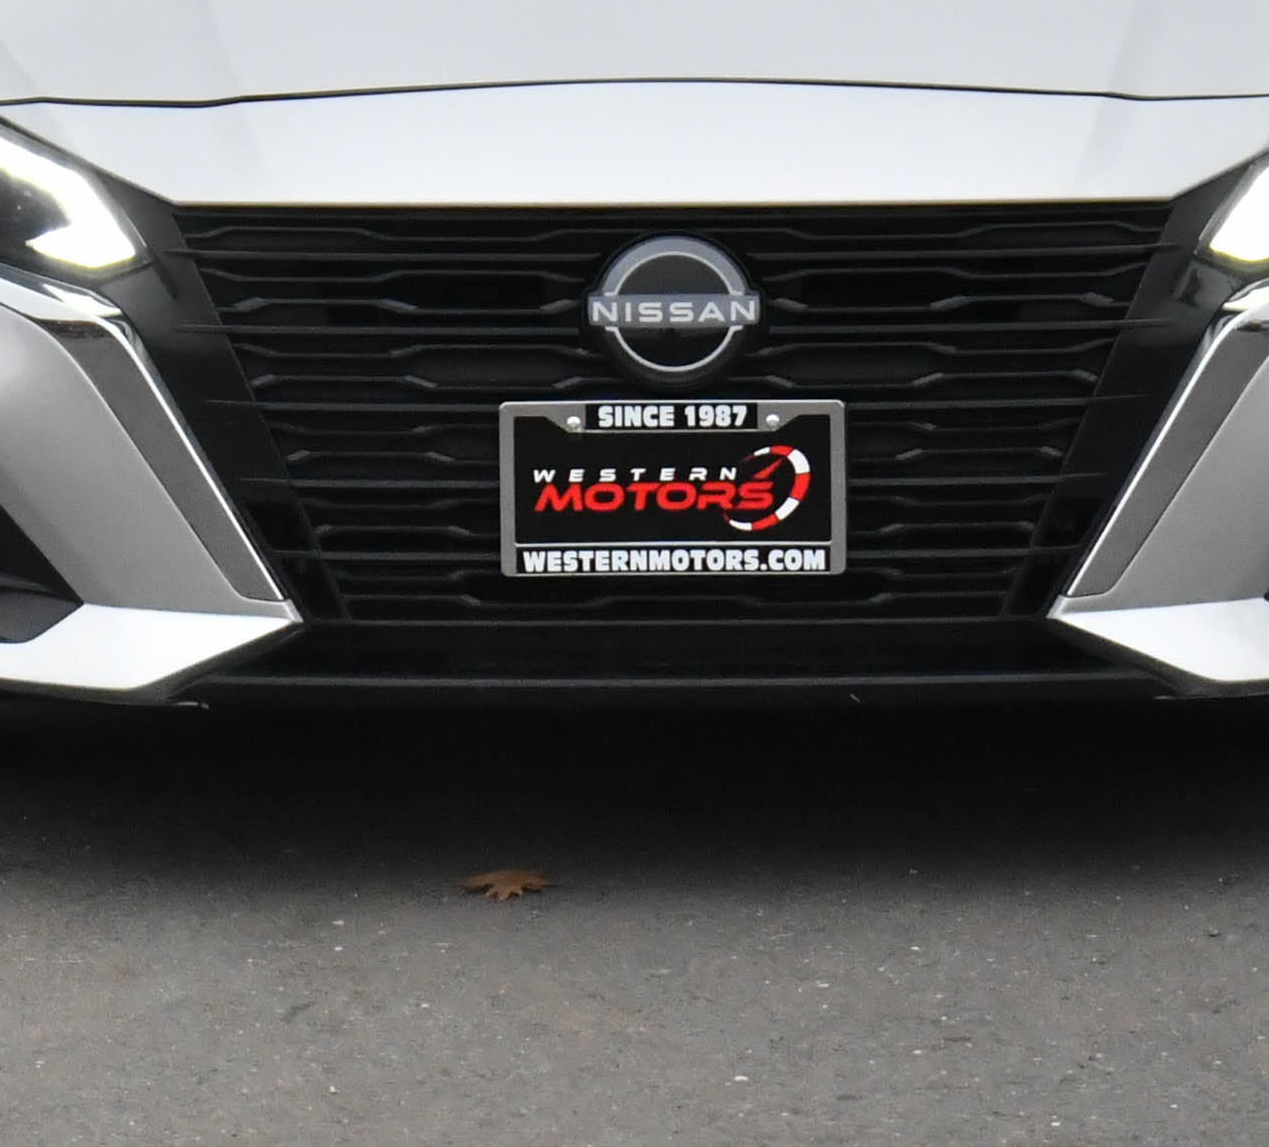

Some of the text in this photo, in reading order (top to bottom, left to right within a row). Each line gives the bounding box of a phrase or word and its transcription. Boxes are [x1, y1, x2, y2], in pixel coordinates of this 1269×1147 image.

[592, 300, 756, 323] NISSAN
[597, 405, 748, 428] SINCE 1987
[533, 467, 737, 484] WESTERN
[534, 481, 774, 512] MOTORS
[522, 549, 827, 572] WESTERNMOTORS.COM
